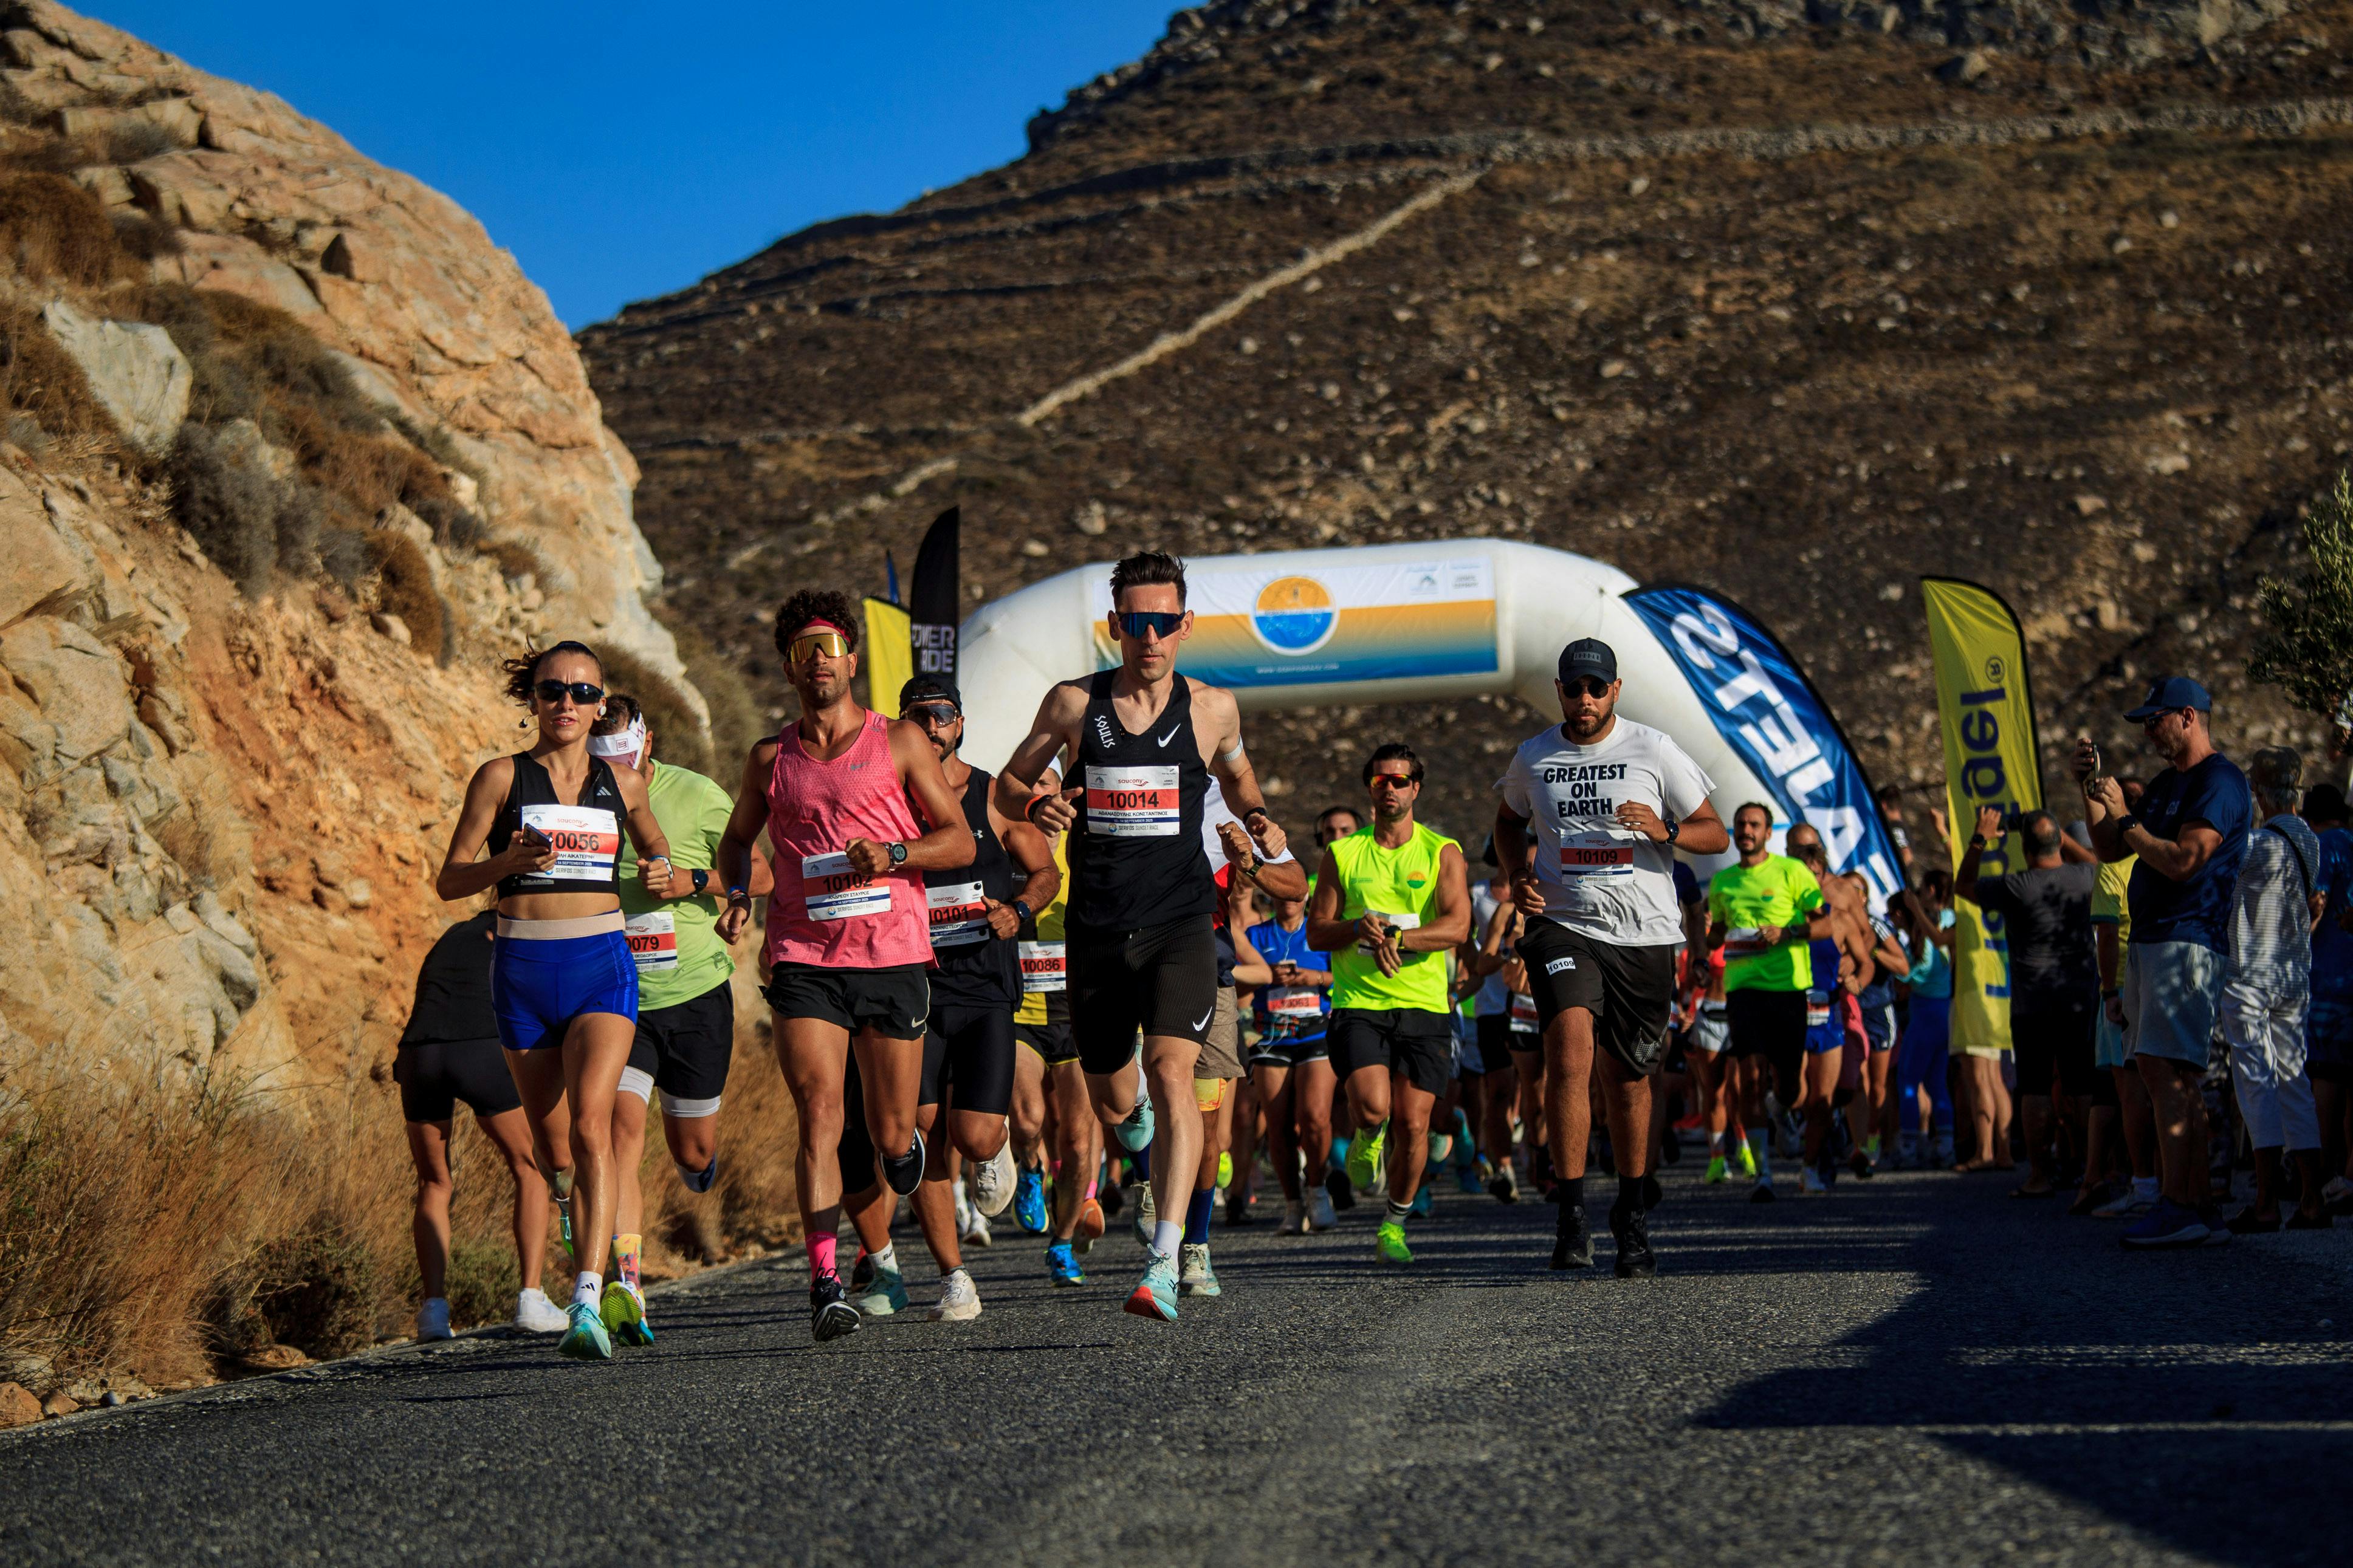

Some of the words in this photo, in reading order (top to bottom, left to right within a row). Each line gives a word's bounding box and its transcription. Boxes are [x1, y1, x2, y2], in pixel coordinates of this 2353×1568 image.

[1544, 764, 1627, 784] GREATEST
[1571, 782, 1597, 798] ON
[1107, 792, 1159, 809] 10014
[1557, 798, 1613, 818] EARTH
[1575, 850, 1618, 863] 10109
[823, 873, 873, 892] 10102
[929, 906, 969, 923] 10101
[625, 936, 659, 951] 0079
[1022, 959, 1060, 972] 10086
[1548, 961, 1574, 972] 10109
